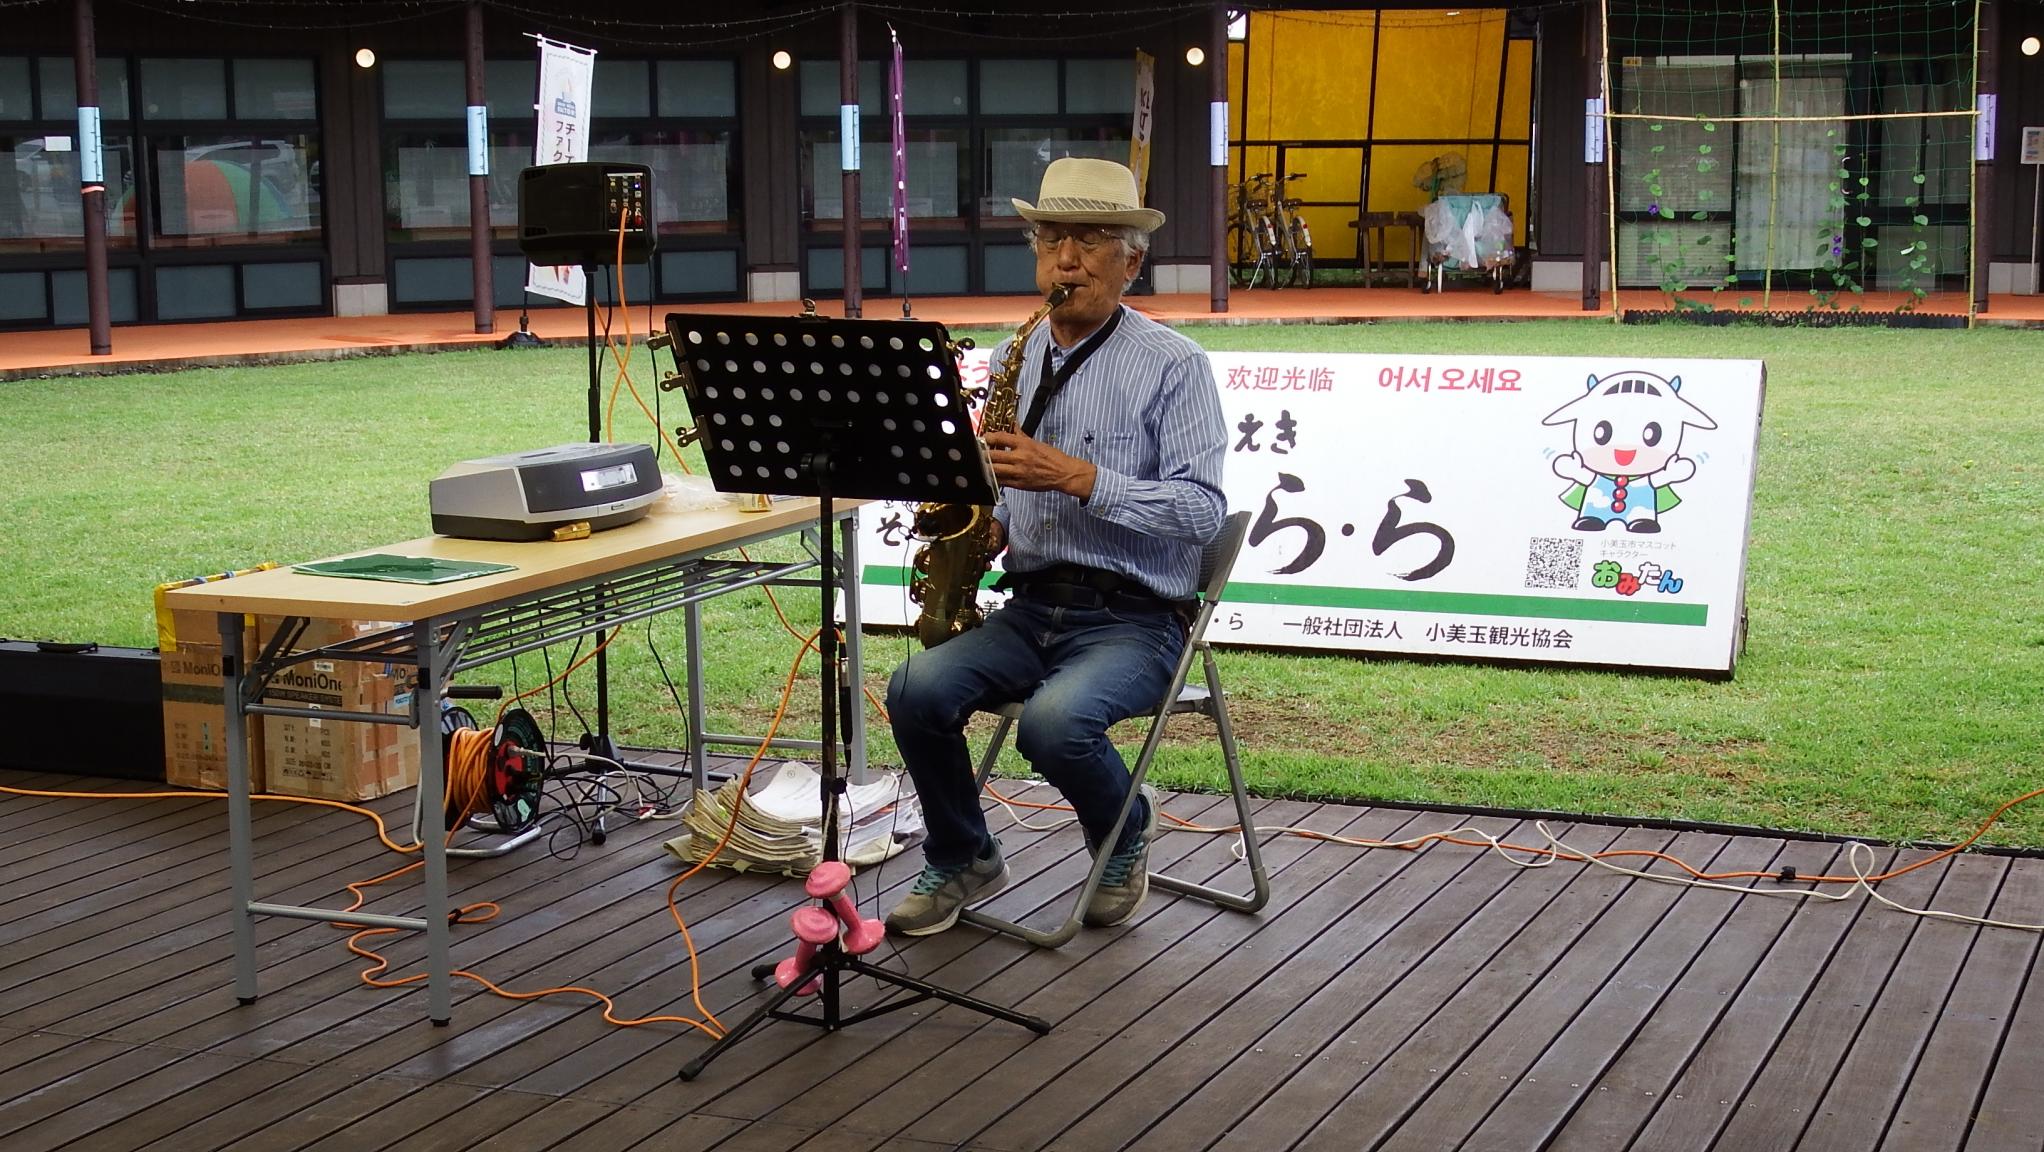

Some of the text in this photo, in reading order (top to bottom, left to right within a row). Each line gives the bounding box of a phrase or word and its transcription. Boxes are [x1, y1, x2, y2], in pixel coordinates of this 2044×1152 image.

[1226, 366, 1335, 392] 欢迎光临
[1378, 367, 1522, 394] 어서 오세요
[1234, 409, 1298, 455] えき
[1591, 560, 1684, 596] おみたん
[1283, 616, 1403, 640] 一般社団法人
[1425, 623, 1574, 650] 小美玉観光協会
[183, 661, 221, 677] MoniO
